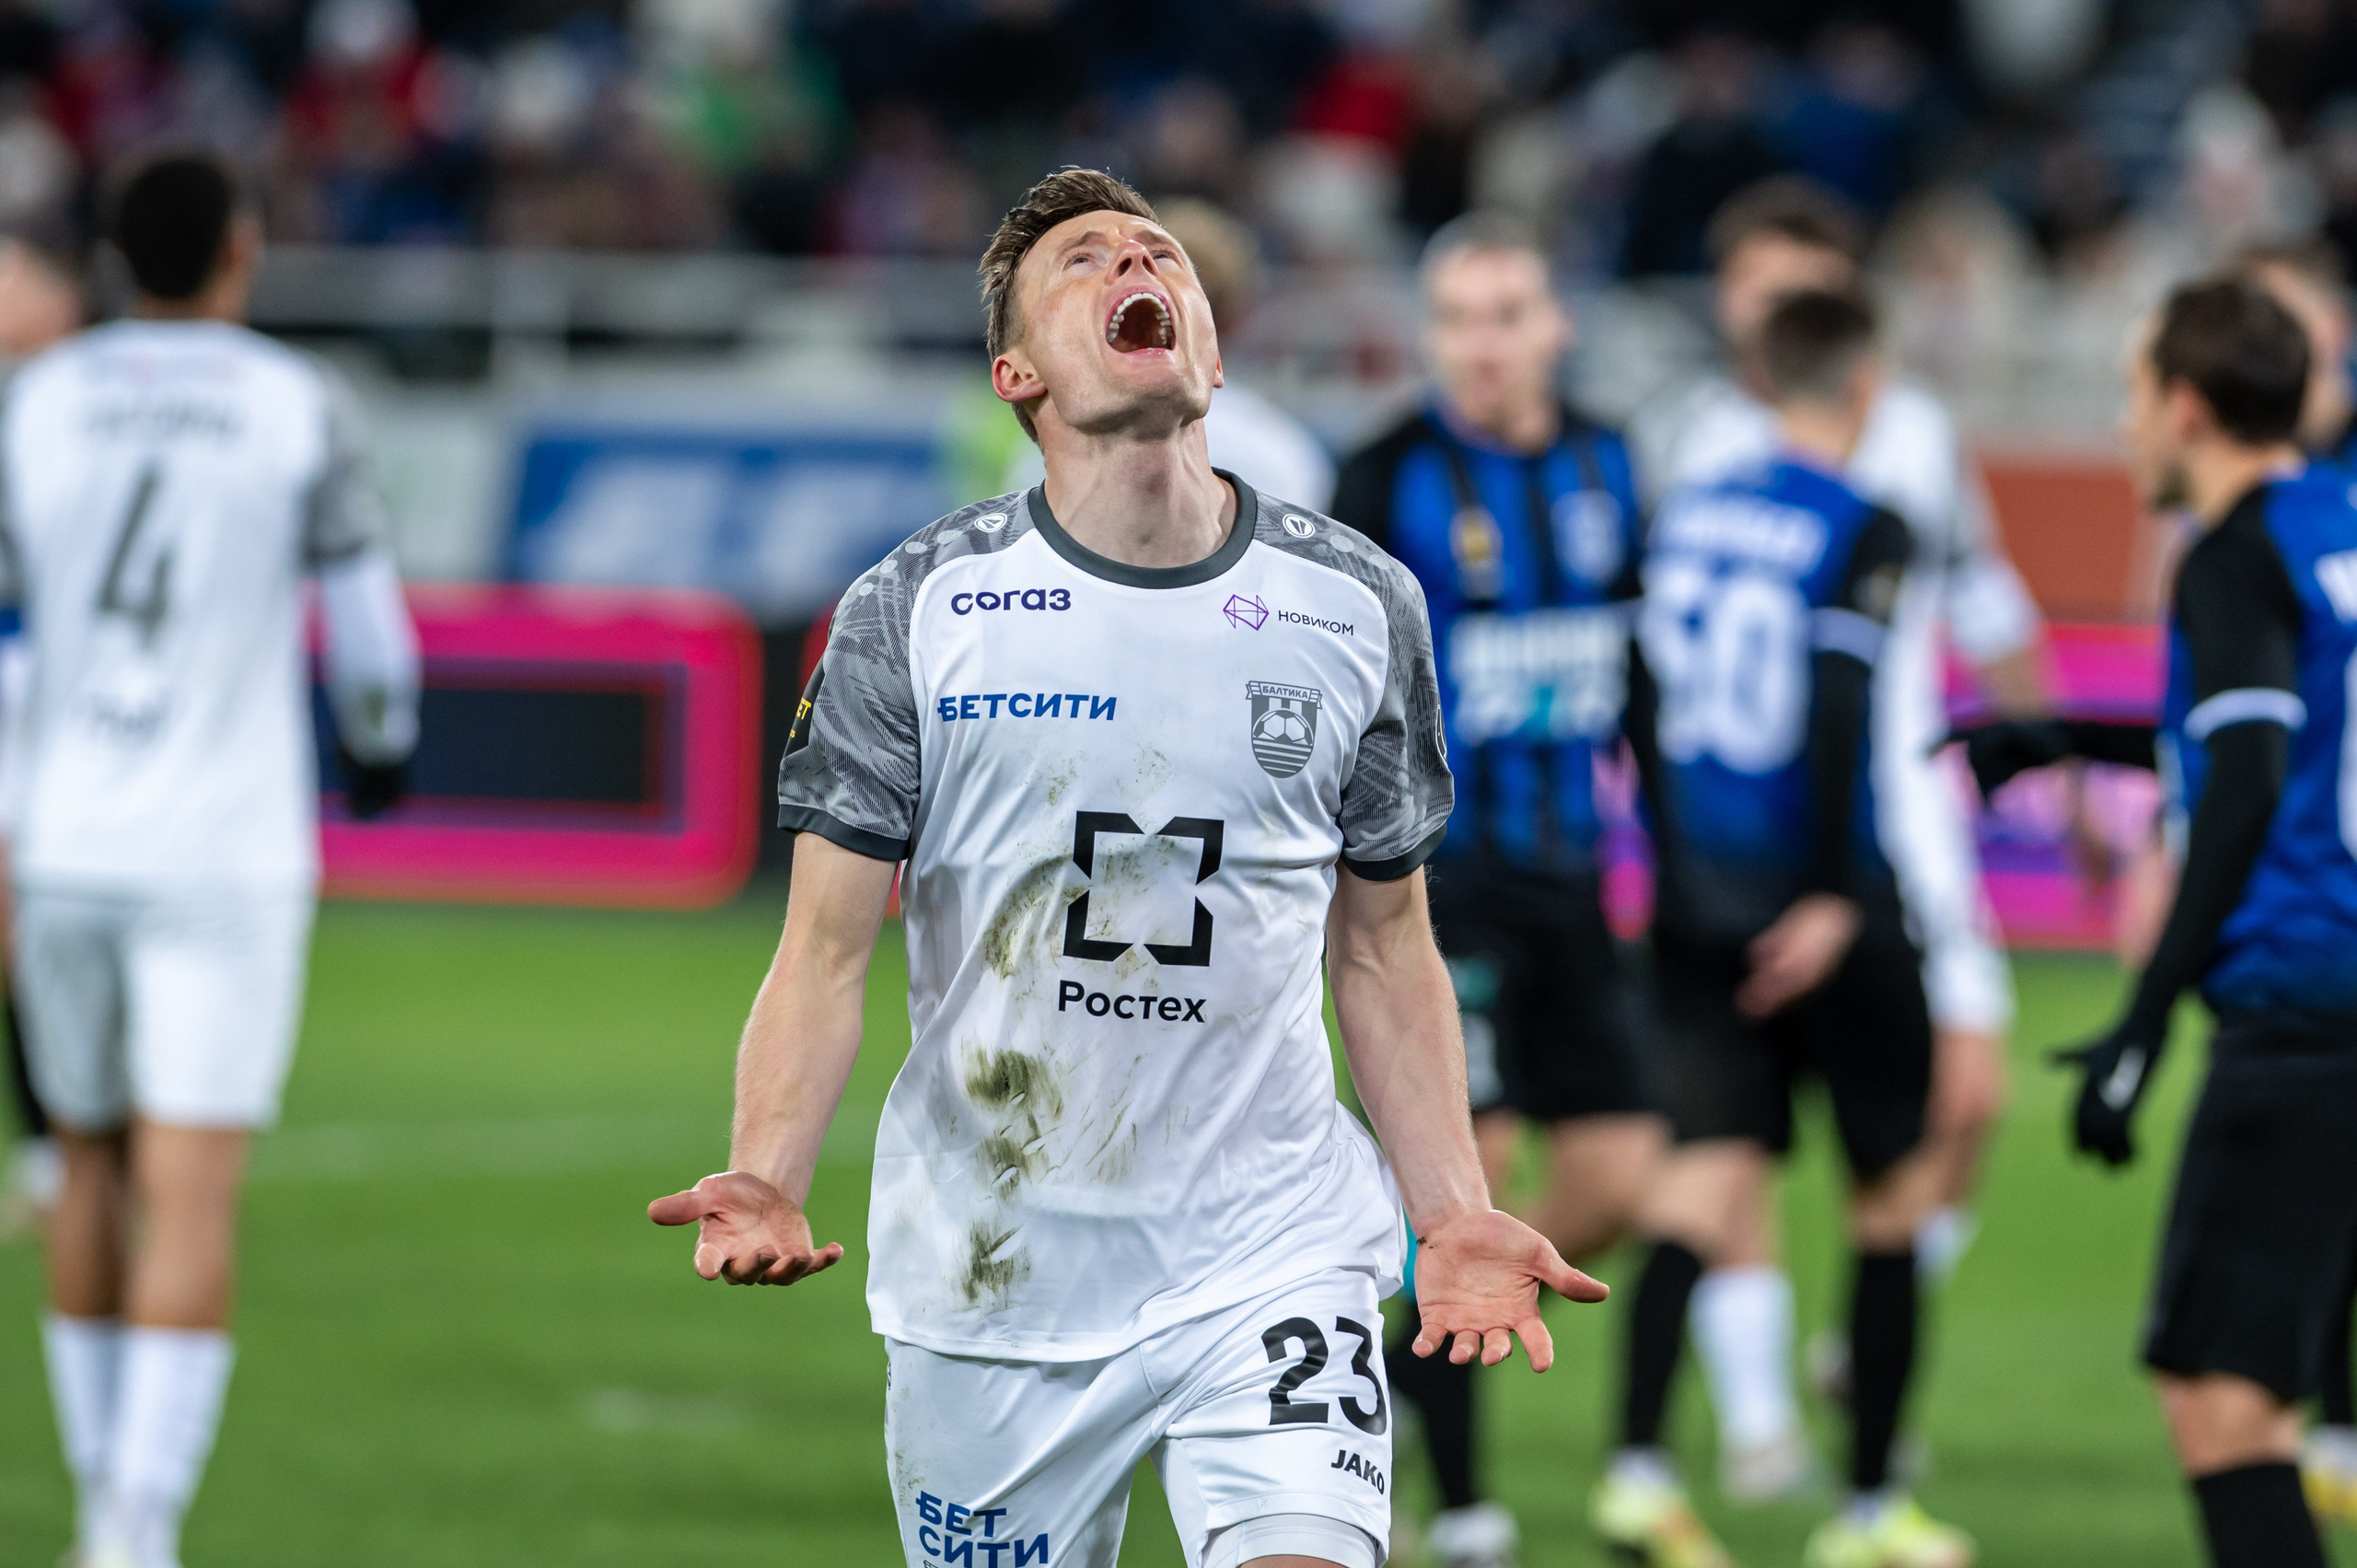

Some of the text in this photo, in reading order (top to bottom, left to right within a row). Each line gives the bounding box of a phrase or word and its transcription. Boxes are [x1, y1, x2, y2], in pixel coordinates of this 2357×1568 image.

[95, 460, 173, 650] 4
[1278, 610, 1354, 636] НОВИКОМ
[937, 692, 1118, 723] БЕТСИТИ
[1262, 685, 1308, 700] БАЛТИКА
[1058, 980, 1207, 1023] Ростех
[1260, 1316, 1387, 1436] 23
[1330, 1449, 1385, 1495] JAKO
[915, 1491, 1007, 1538] БЕТ
[919, 1525, 1049, 1568] СИТИ
